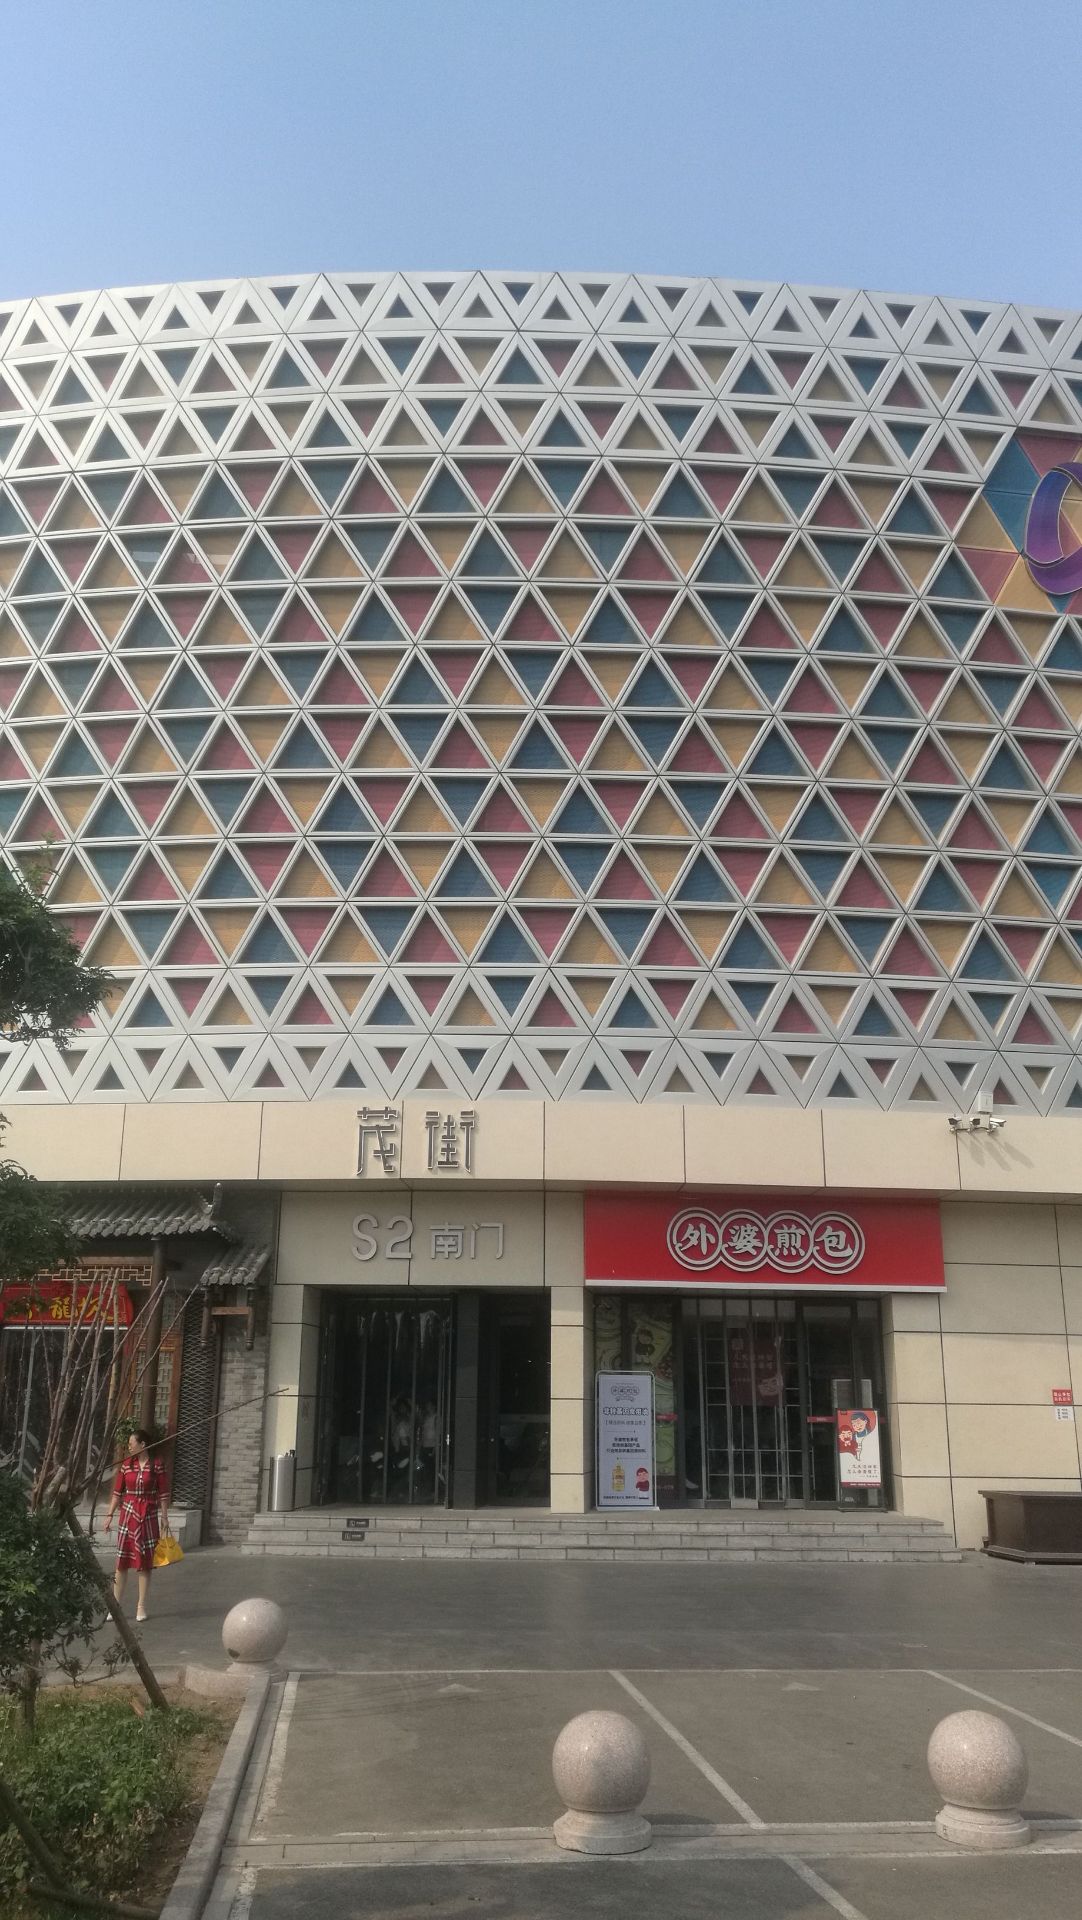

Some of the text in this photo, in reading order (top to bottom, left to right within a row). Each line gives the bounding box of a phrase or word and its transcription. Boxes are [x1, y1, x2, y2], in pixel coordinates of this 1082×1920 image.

[357, 1106, 474, 1175] 茂街
[352, 1213, 504, 1261] S2 南门
[681, 1223, 854, 1258] 外婆煎包
